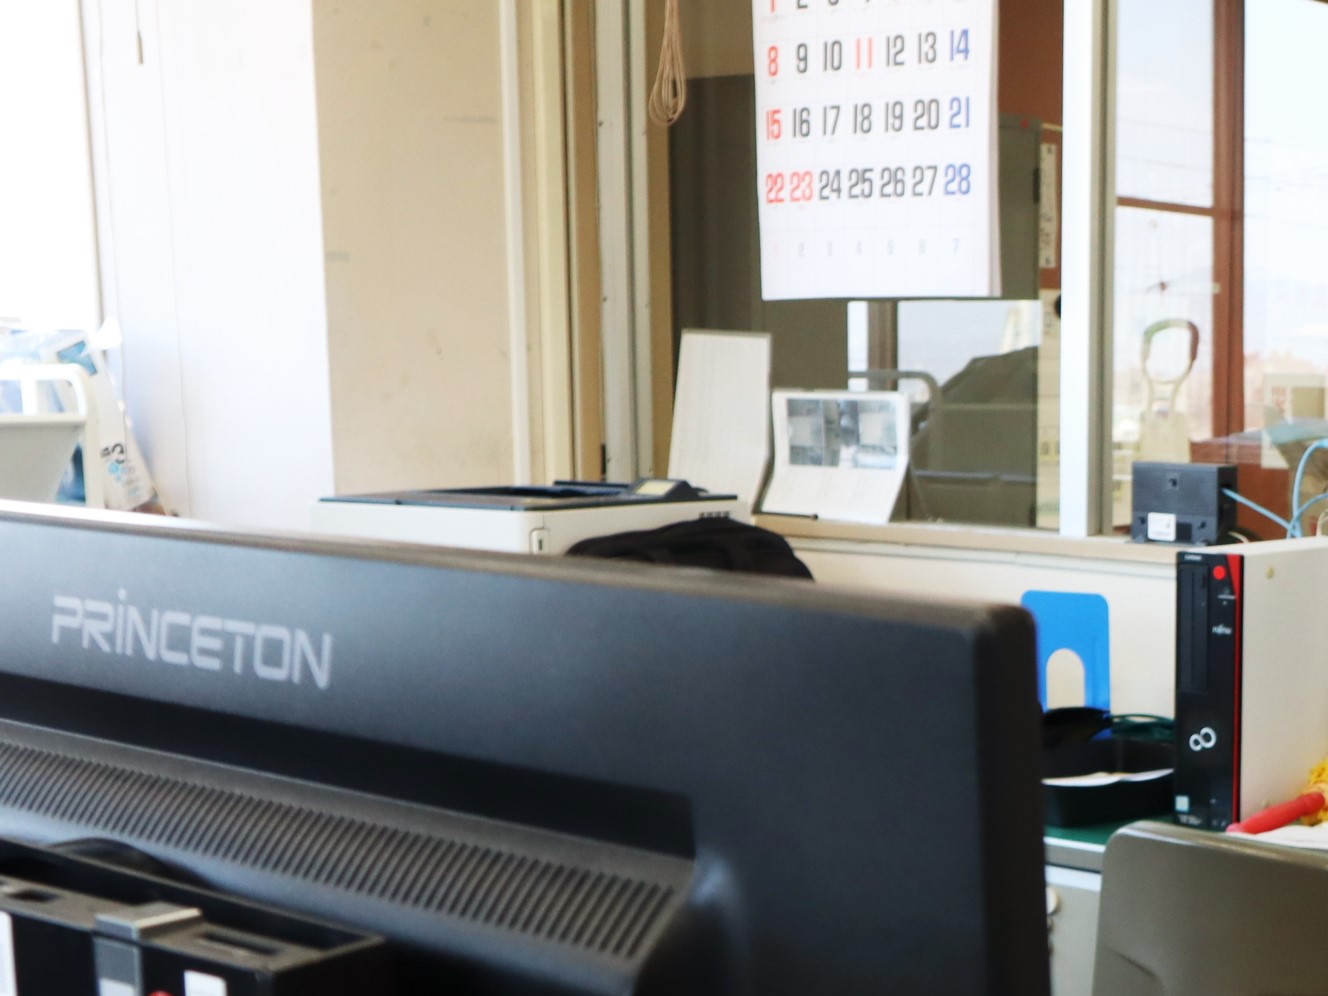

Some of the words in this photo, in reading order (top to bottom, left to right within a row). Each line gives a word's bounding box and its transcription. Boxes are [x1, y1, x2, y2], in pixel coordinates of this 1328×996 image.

[768, 46, 778, 76] 8
[797, 44, 808, 74] 9
[824, 41, 842, 71] 10
[856, 37, 873, 69] 11
[886, 35, 905, 67] 12
[918, 32, 937, 64] 13
[950, 29, 970, 61] 14
[766, 109, 781, 140] 15
[793, 108, 810, 138] 16
[823, 105, 840, 136] 17
[853, 103, 872, 134] 18
[885, 101, 903, 132] 19
[914, 99, 940, 131] 20
[949, 96, 970, 129] 21
[766, 173, 785, 203] 22
[790, 171, 813, 202] 23
[819, 169, 841, 200] 24
[848, 168, 873, 199] 25
[880, 167, 905, 197] 26
[912, 165, 938, 196] 27
[945, 163, 971, 195] 28
